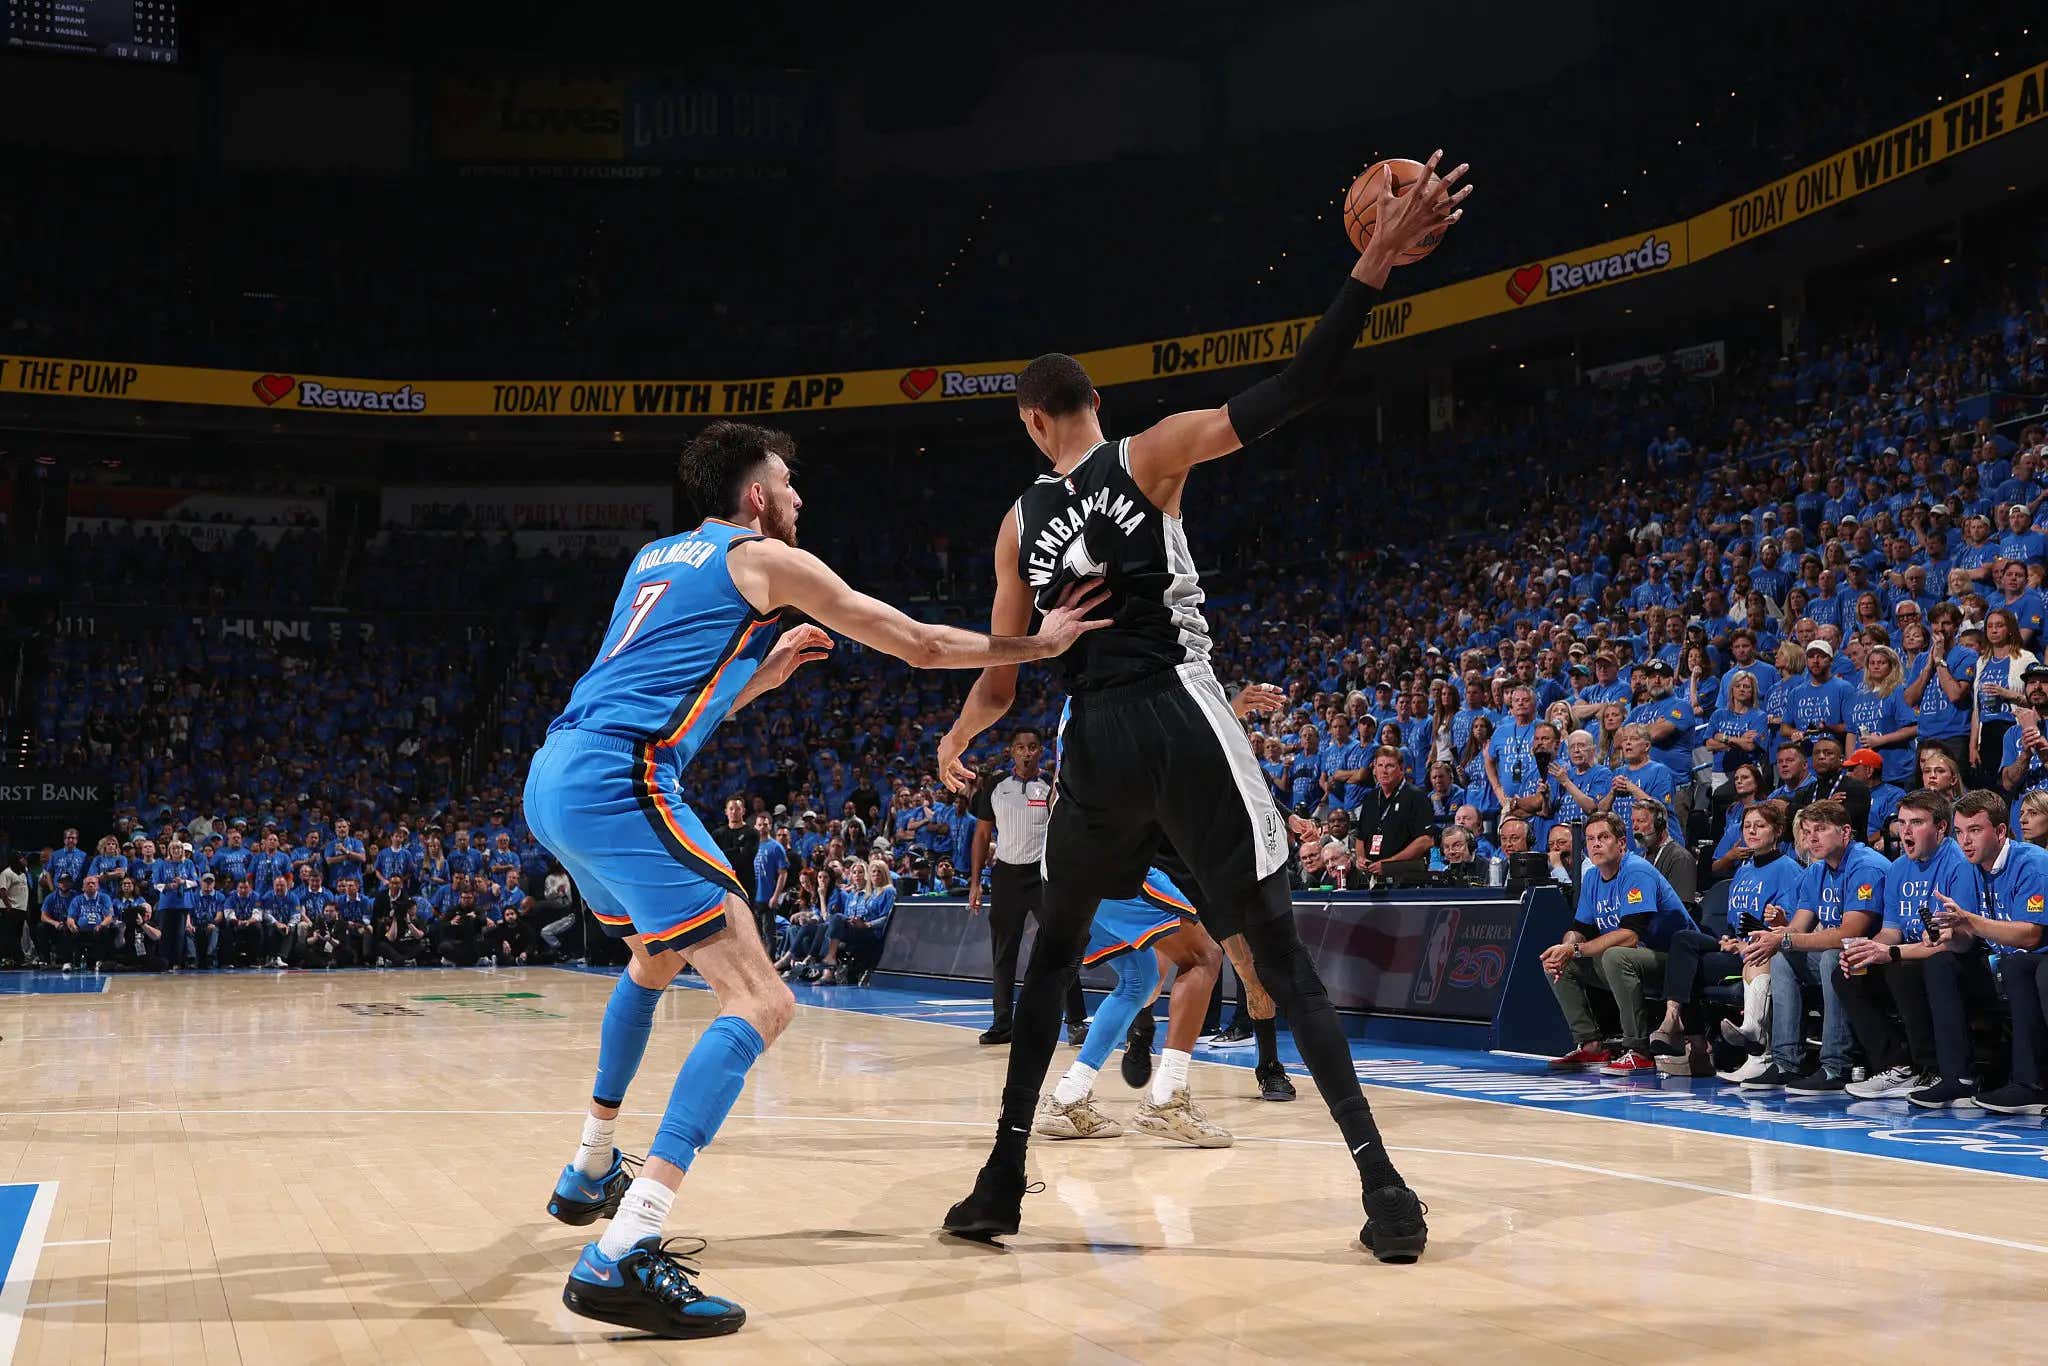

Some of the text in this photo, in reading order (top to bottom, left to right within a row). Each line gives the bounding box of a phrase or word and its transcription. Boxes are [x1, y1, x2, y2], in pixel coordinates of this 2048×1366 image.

[54, 15, 85, 24] BRYANT
[55, 3, 85, 13] CASTLE
[55, 28, 88, 37] VASSELL
[1729, 66, 2048, 241] TODAY ONLY WITH THE A
[1548, 236, 1672, 294] Rewards
[1152, 342, 1200, 375] 10x
[1202, 331, 1274, 365] POINTS
[18, 361, 60, 390] THE
[67, 366, 138, 395] PUMP
[493, 377, 845, 413] TODAY ONLY WITH THE APP
[941, 370, 1018, 396] Rewa
[301, 383, 426, 412] Rewards
[1028, 486, 1147, 588] WEMBANAMA
[602, 580, 672, 663] 7
[1460, 922, 1513, 941] AMERICA
